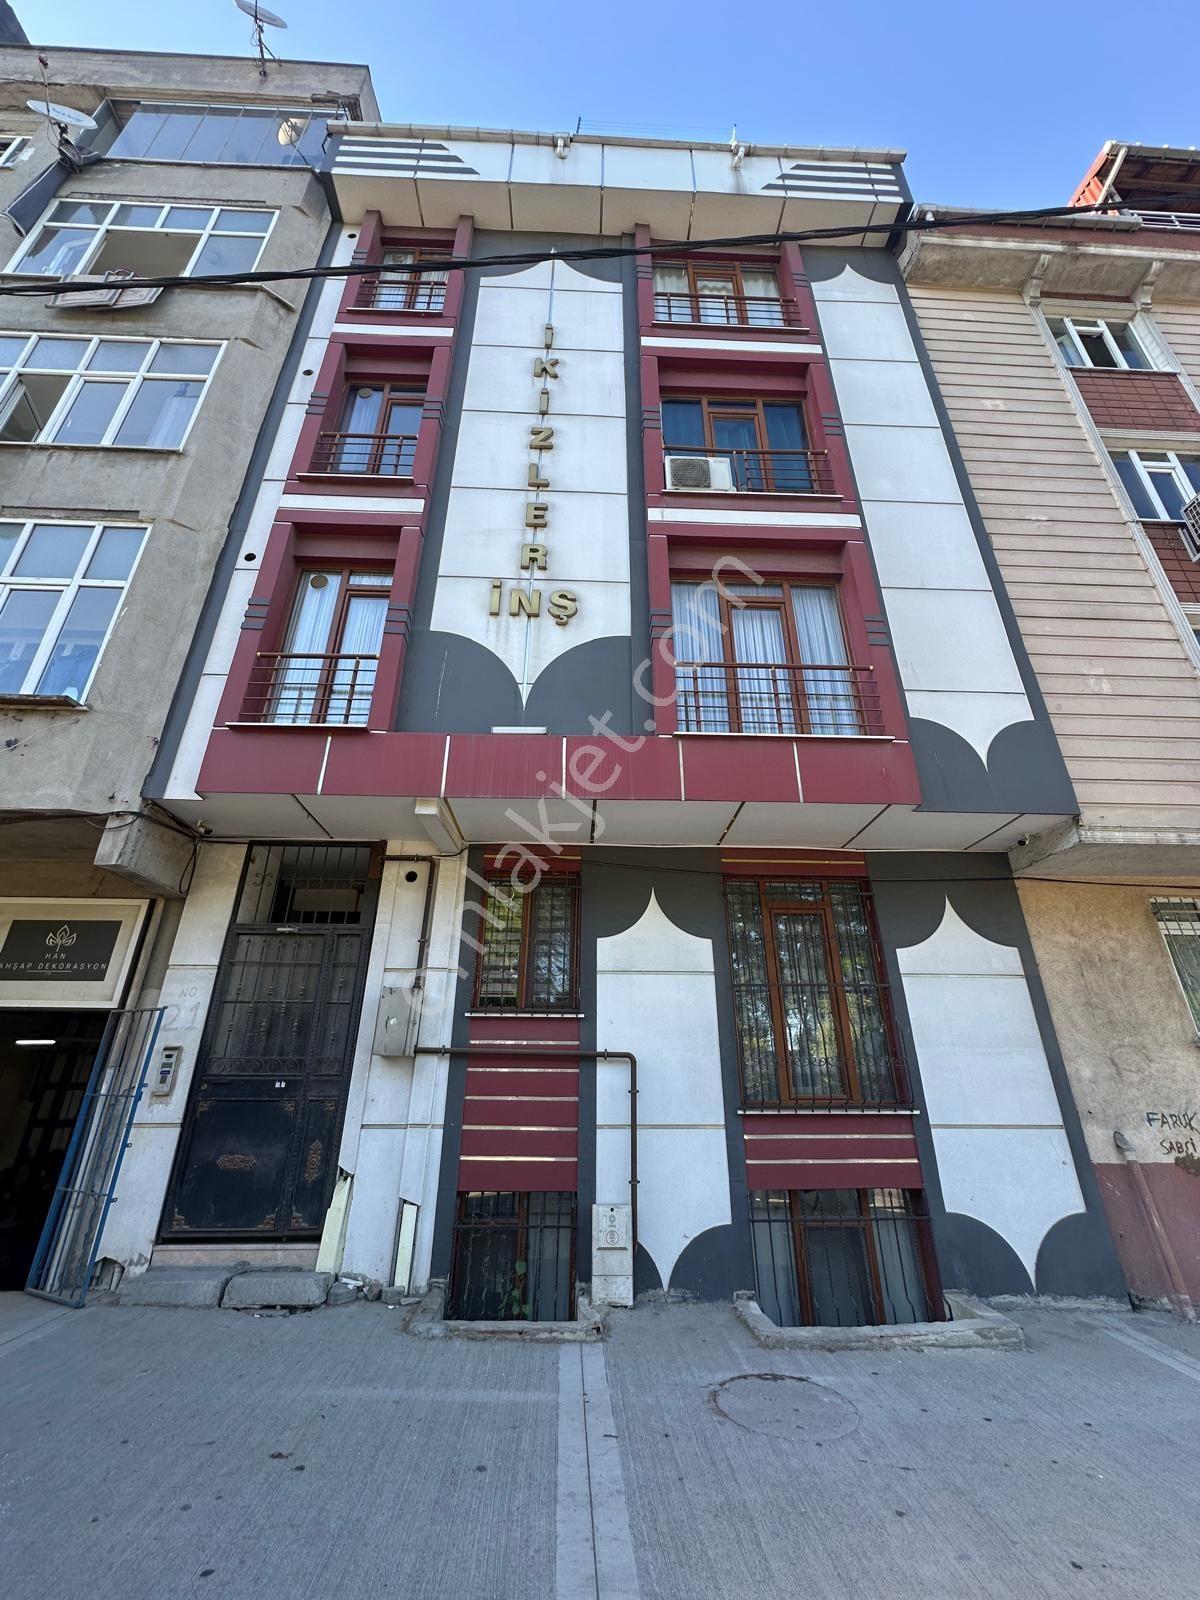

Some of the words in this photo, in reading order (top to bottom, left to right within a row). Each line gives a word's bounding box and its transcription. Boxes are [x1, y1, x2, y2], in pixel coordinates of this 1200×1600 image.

[520, 323, 560, 570] İKİZLER
[489, 579, 579, 626] İNŞ
[45, 952, 67, 960] HAN
[37, 962, 107, 970] DEKORASYON
[180, 987, 198, 998] NO
[1146, 1111, 1200, 1135] FARUK
